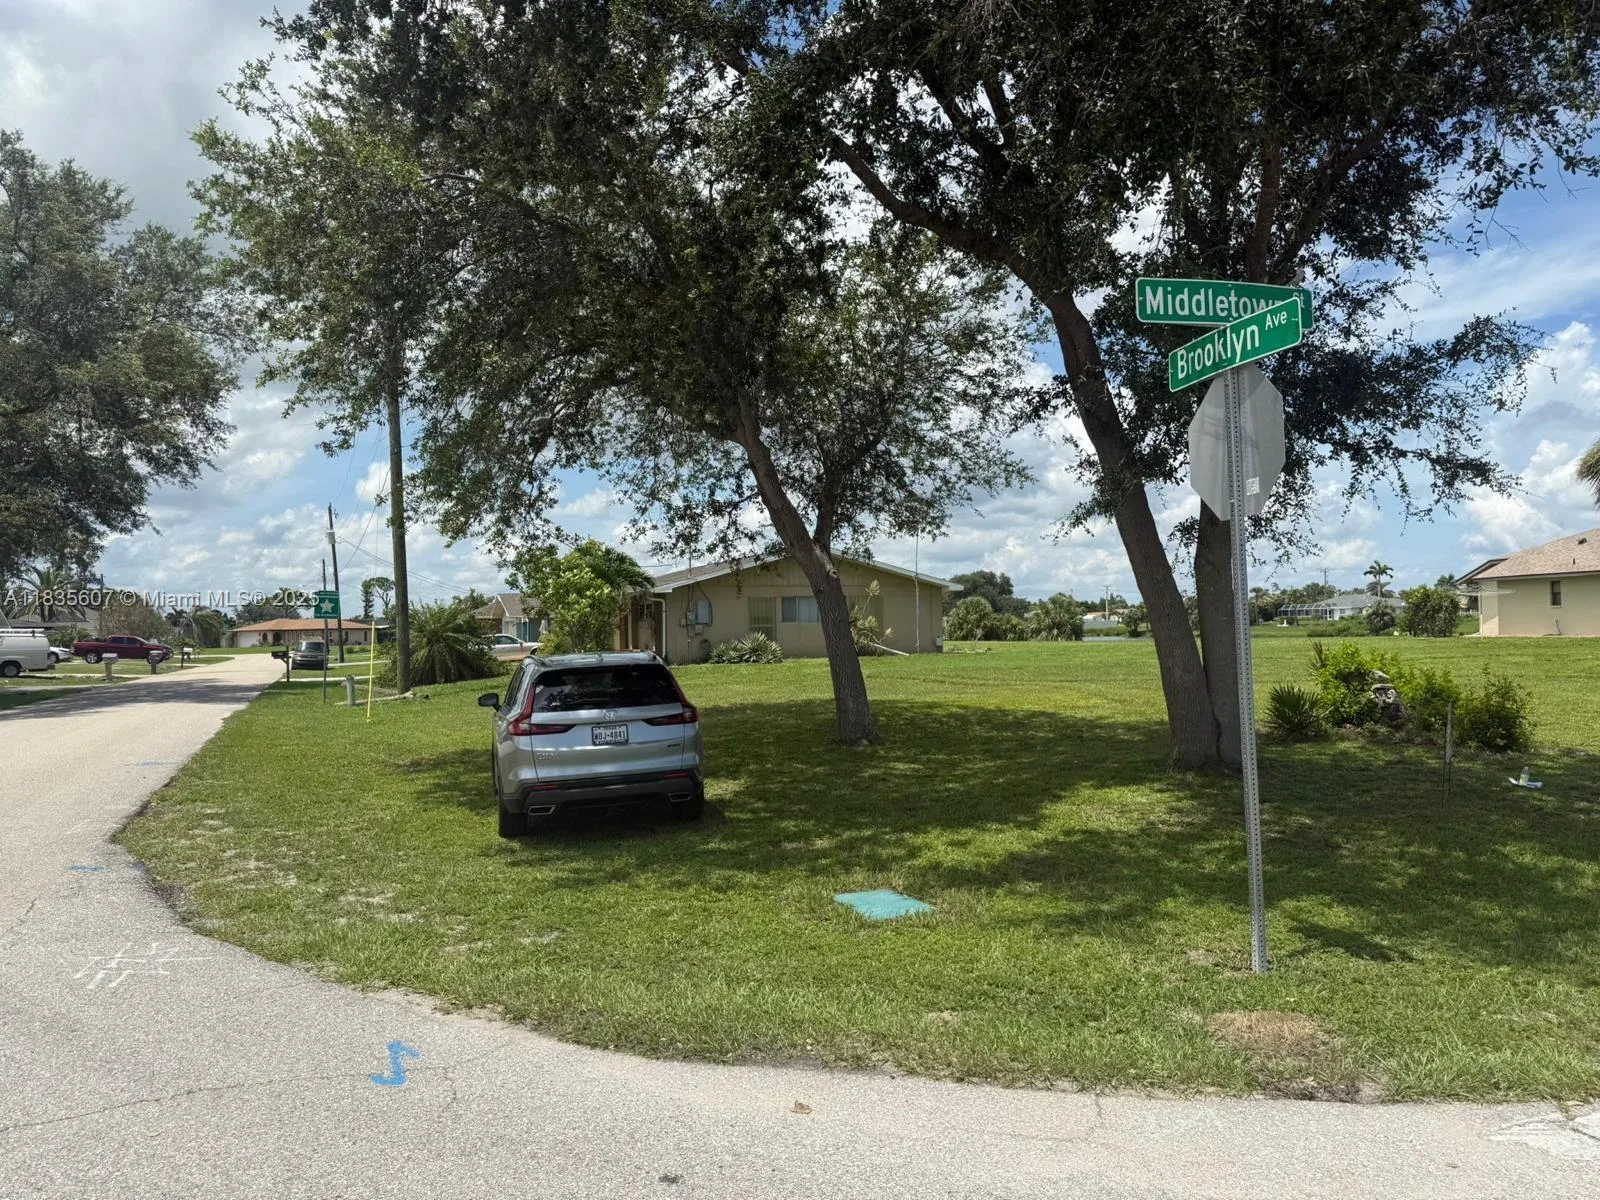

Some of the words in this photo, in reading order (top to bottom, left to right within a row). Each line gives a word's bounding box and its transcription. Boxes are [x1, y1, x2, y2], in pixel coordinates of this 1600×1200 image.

[1145, 286, 1282, 318] Middletow
[1177, 324, 1260, 380] Brooklyn
[1265, 311, 1288, 331] Ave
